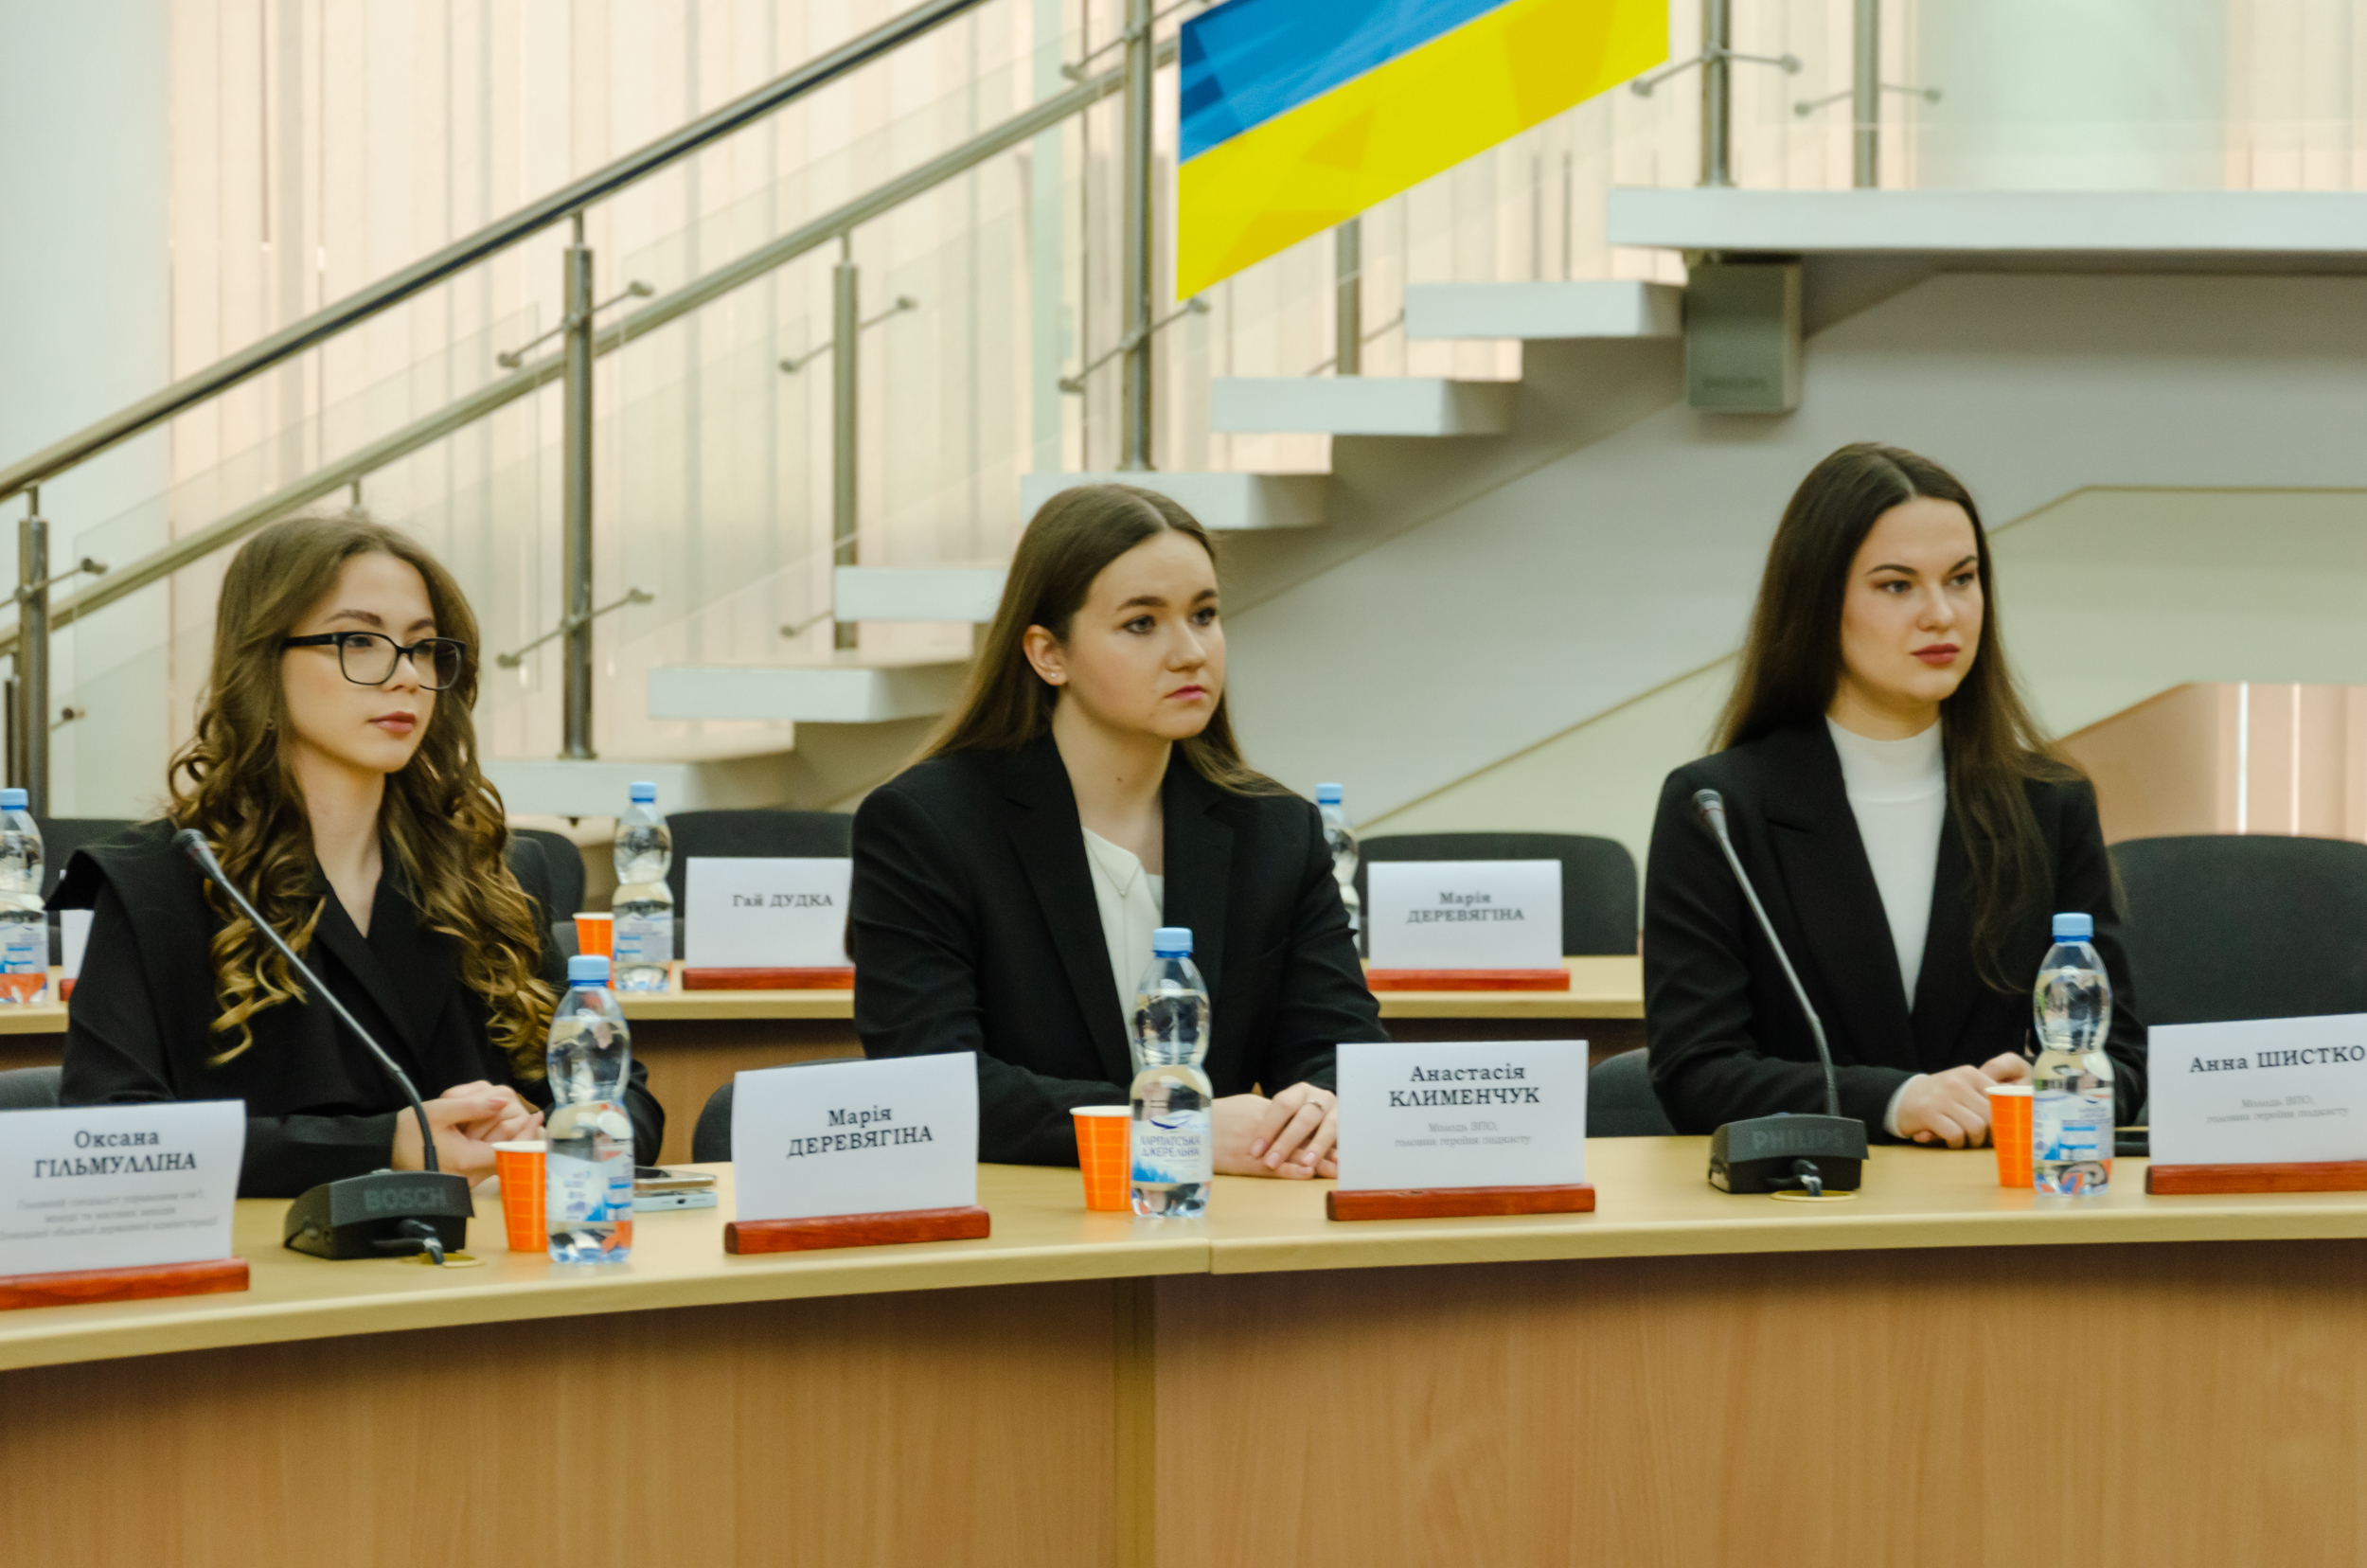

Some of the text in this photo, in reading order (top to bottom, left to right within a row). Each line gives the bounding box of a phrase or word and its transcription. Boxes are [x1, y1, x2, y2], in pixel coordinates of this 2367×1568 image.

[732, 893, 834, 908] Гай ДУДКА
[1438, 891, 1492, 907] Марія
[1406, 908, 1525, 924] ДЕРЕВЯГІНА
[2188, 1044, 2366, 1074] Анна ШИСТКО
[1410, 1062, 1525, 1082] Анастасія
[1388, 1086, 1540, 1108] КЛИМЕНЧУК
[827, 1105, 892, 1128] Марія
[74, 1131, 160, 1149] Оксана
[787, 1125, 934, 1159] ДЕРЕВЯГІНА
[1751, 1128, 1845, 1151] PHILIPS
[33, 1151, 197, 1178] ГІЛЬМУЛЛІНА
[363, 1185, 448, 1212] BOSCH
